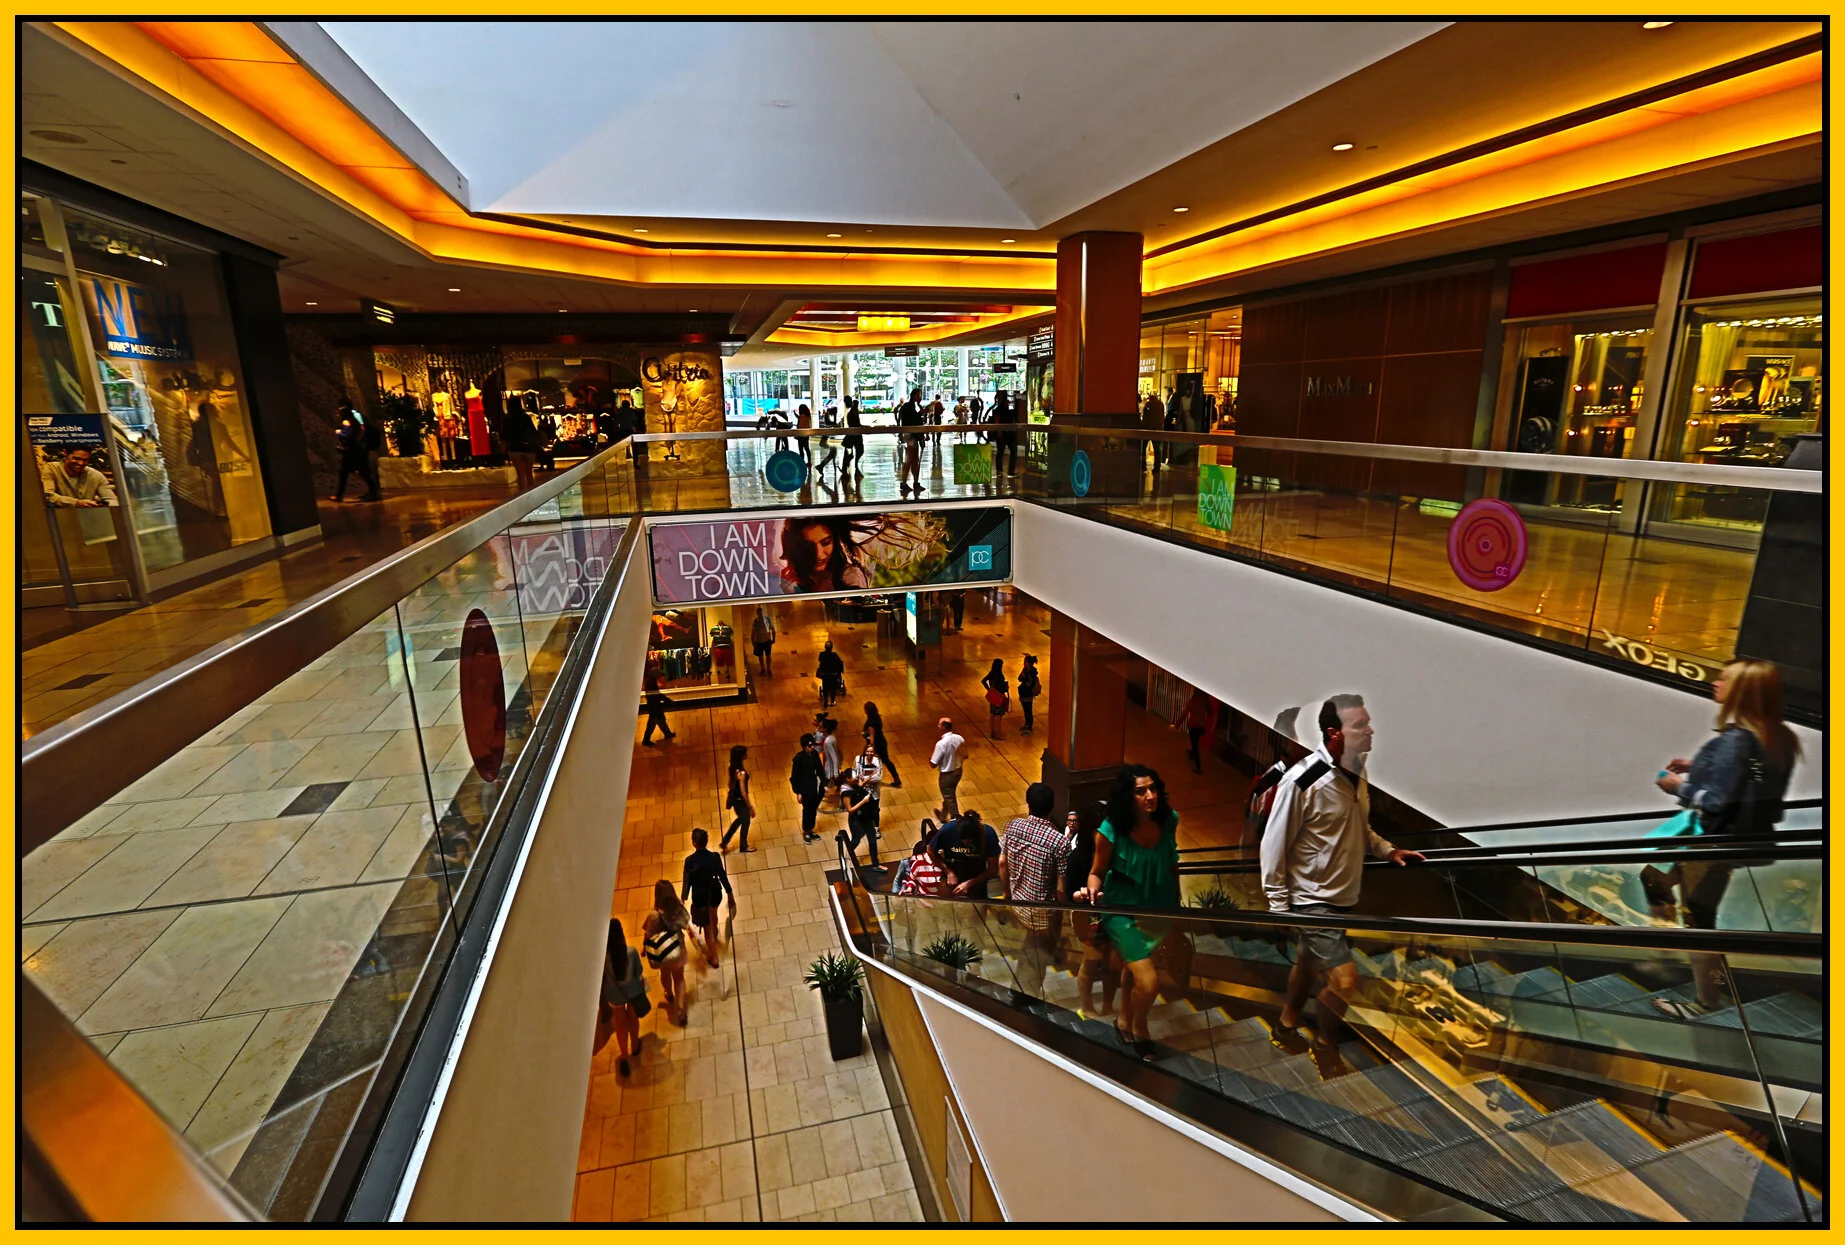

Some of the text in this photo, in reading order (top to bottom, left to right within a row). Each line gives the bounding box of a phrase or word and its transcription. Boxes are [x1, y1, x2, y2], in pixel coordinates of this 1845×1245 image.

[92, 278, 190, 341] NEW
[38, 425, 83, 433] compatible
[219, 461, 248, 473] BOSE
[955, 462, 992, 474] DOWN
[958, 472, 991, 482] TOWN
[1199, 493, 1234, 514] DOWN
[1201, 507, 1232, 530] TOWN
[710, 523, 766, 549] I AM
[678, 547, 768, 576] DOWN
[684, 571, 769, 600] TOWN
